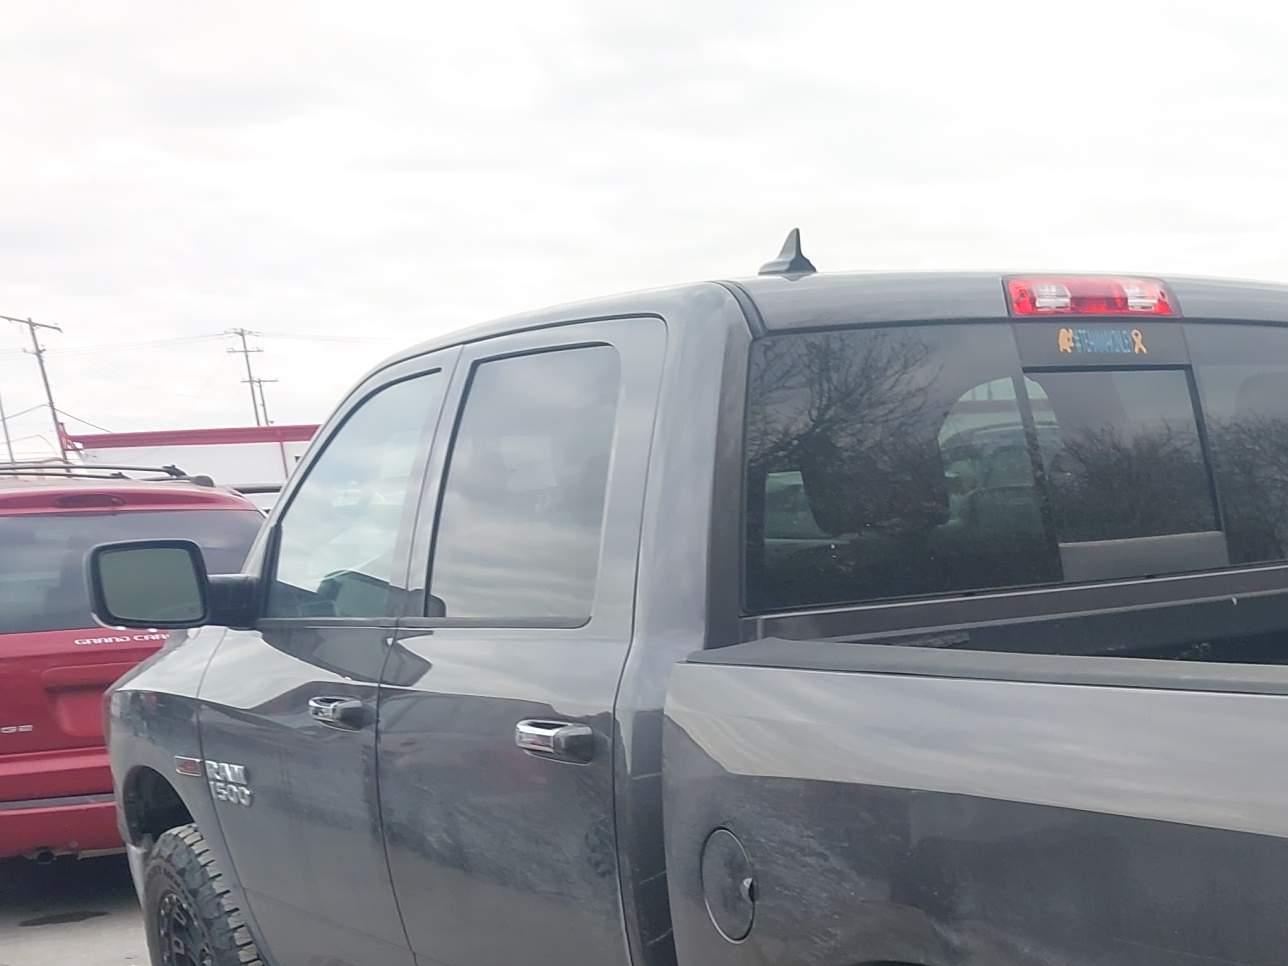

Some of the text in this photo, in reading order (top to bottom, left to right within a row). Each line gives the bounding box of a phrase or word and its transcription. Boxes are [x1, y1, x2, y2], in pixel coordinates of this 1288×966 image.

[74, 635, 131, 645] GRAND
[205, 760, 247, 785] RAM
[209, 781, 252, 806] 1500
